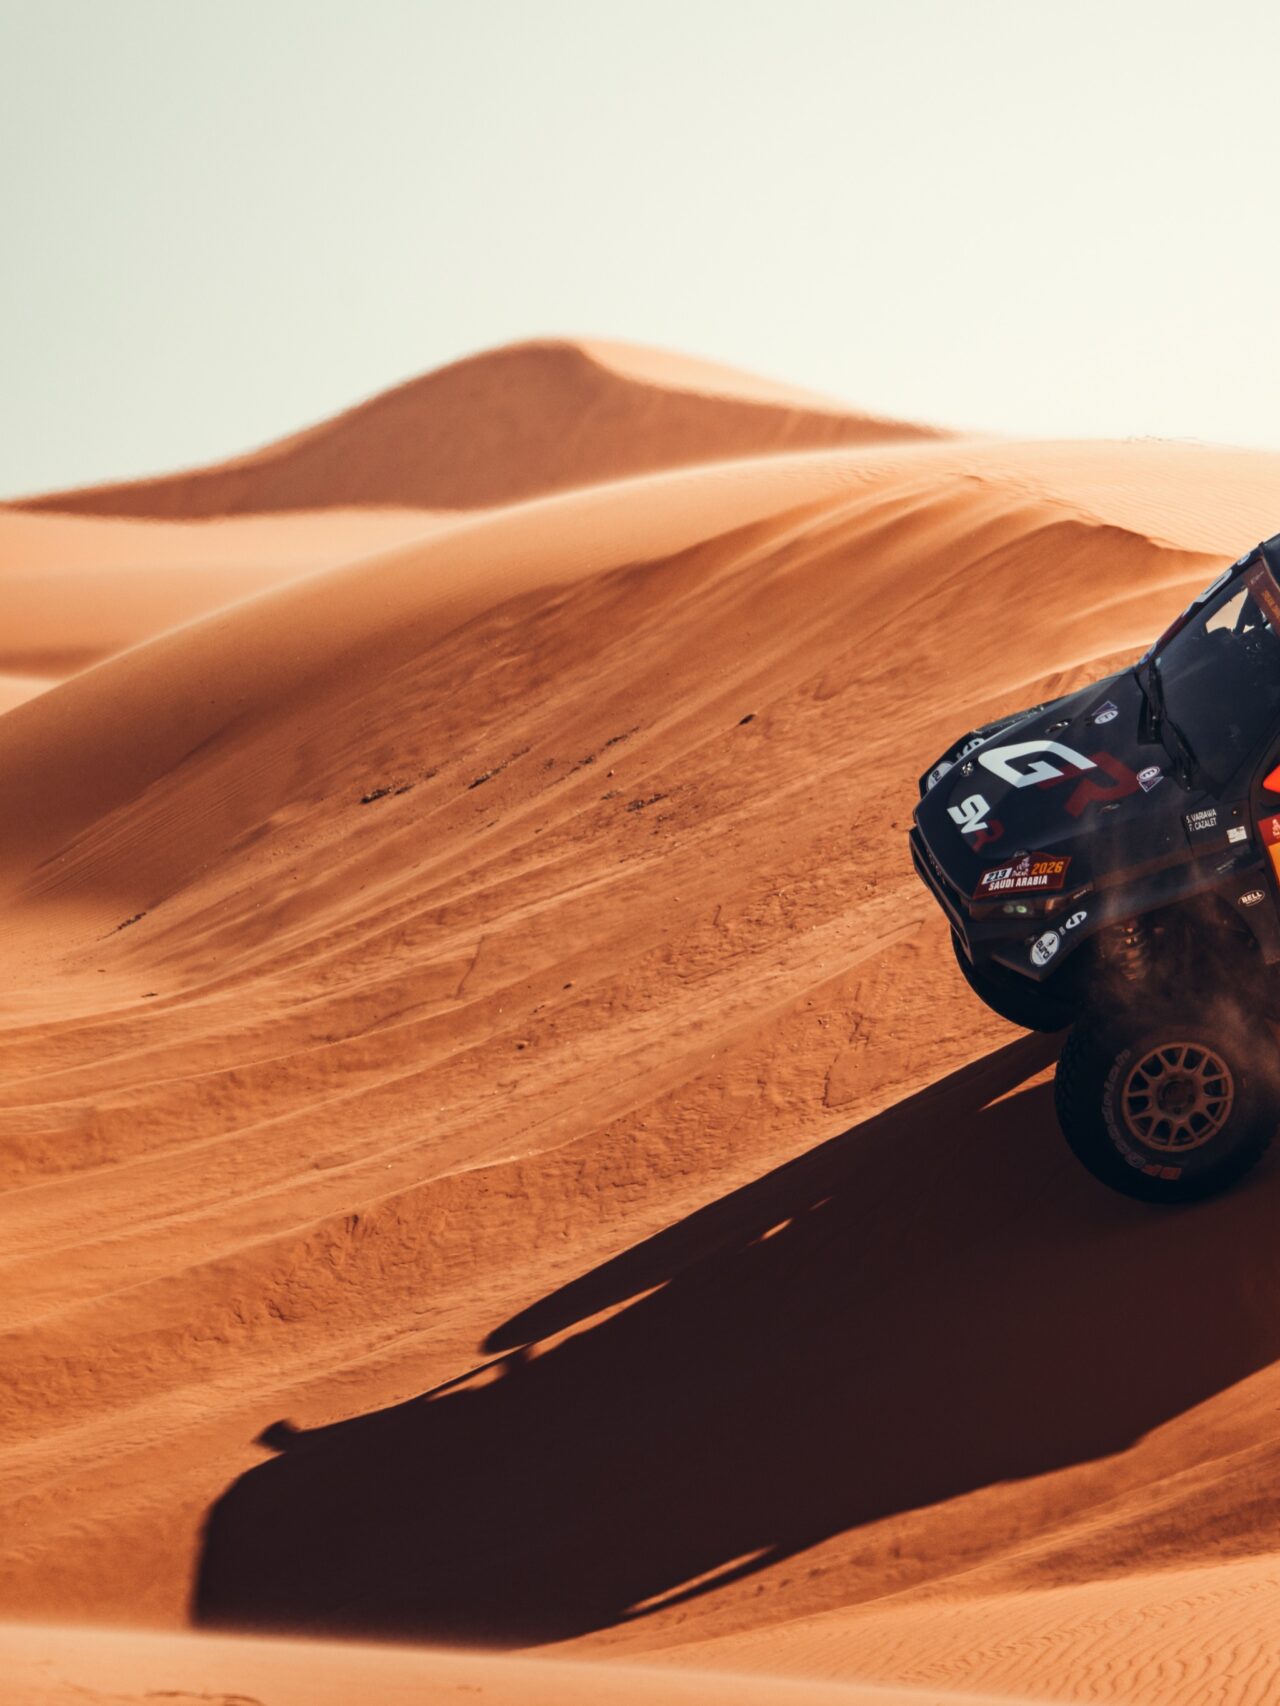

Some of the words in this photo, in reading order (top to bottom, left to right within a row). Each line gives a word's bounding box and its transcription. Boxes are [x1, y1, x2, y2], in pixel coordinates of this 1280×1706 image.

[1031, 861, 1064, 875] 2026
[988, 879, 1014, 891] SAUDI
[1015, 875, 1048, 887] ARABIA
